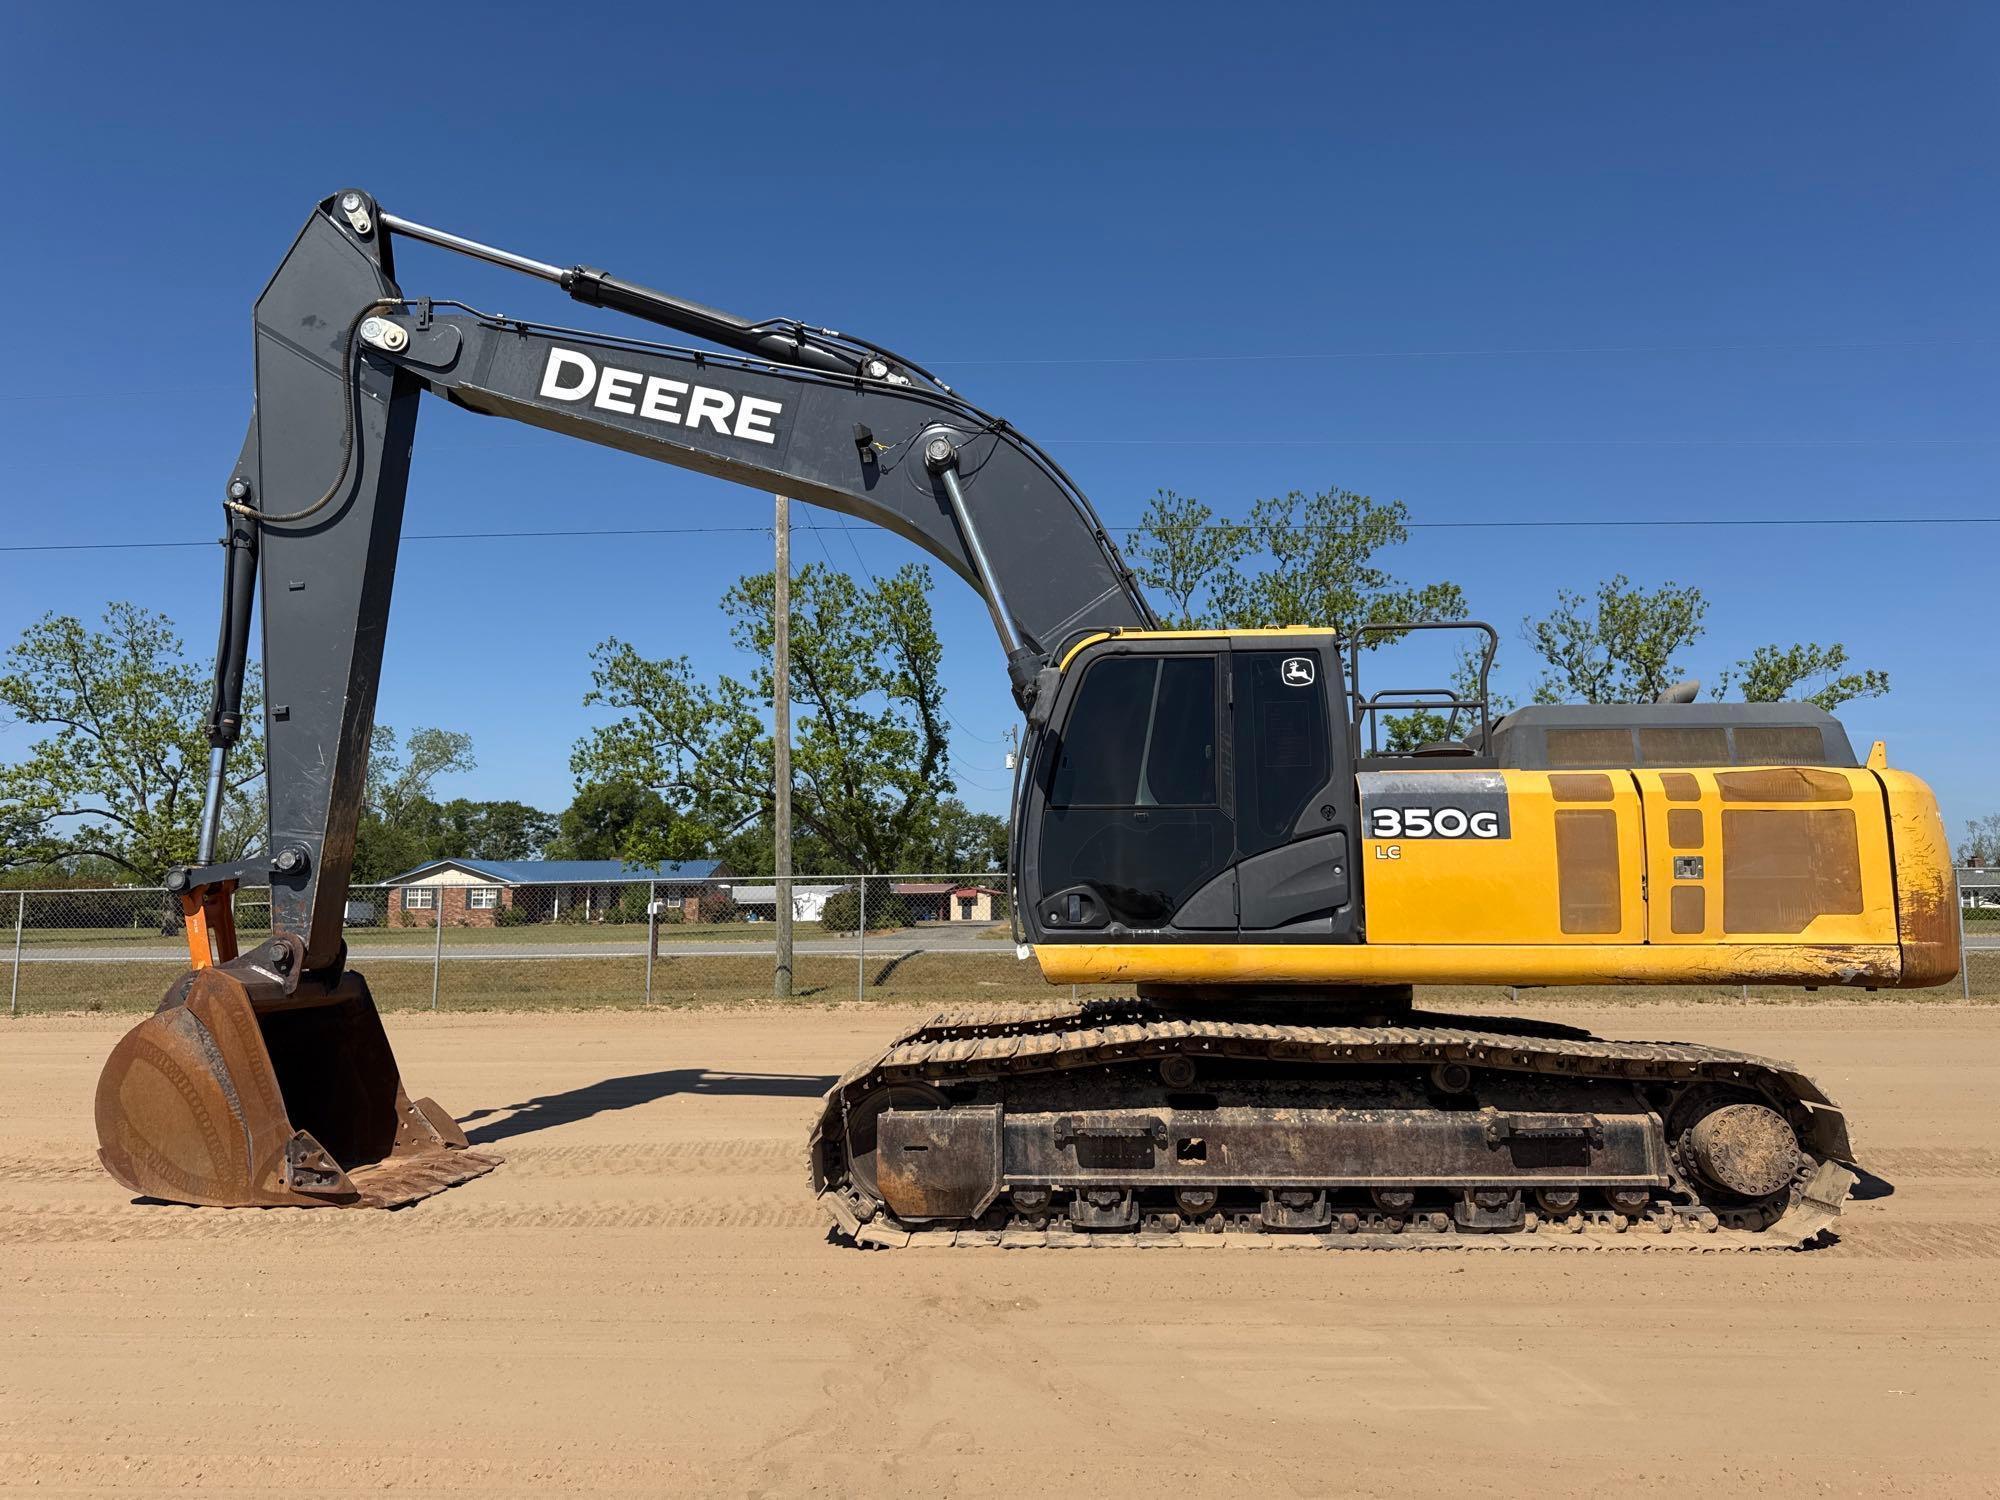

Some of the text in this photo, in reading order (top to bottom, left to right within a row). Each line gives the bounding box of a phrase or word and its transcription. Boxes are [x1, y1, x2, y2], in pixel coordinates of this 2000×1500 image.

[540, 347, 782, 444] DEERE
[1372, 808, 1499, 838] 350G
[1376, 846, 1400, 859] LC
